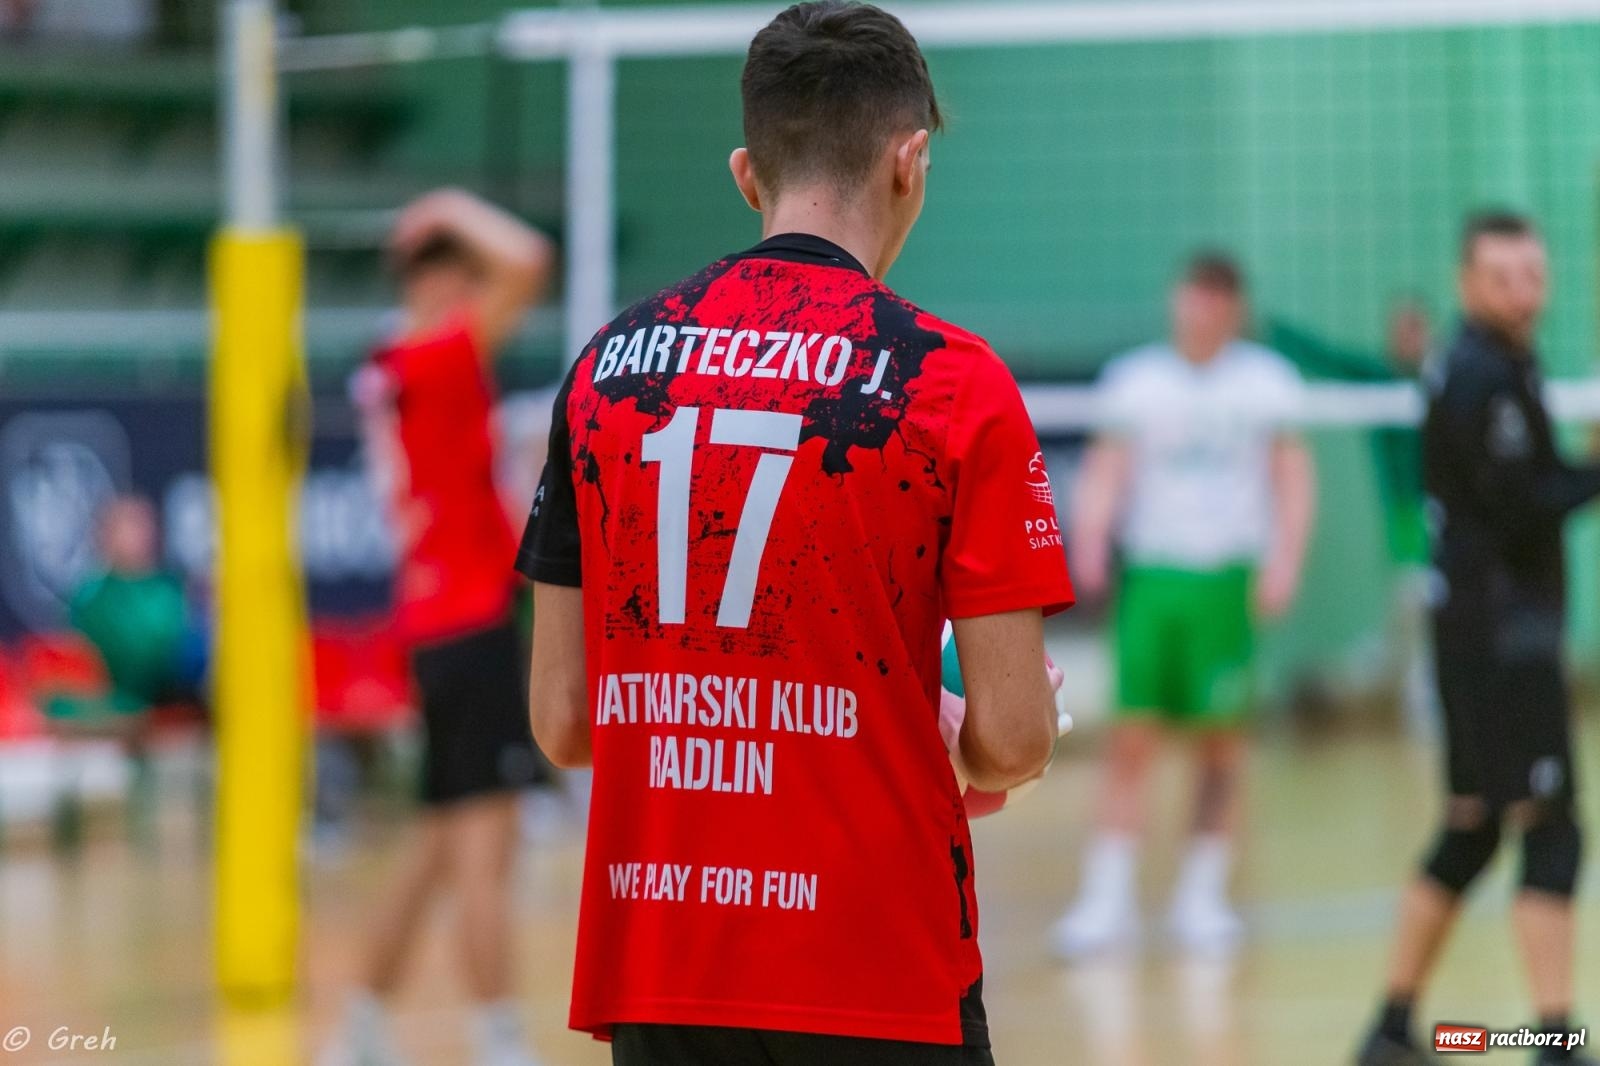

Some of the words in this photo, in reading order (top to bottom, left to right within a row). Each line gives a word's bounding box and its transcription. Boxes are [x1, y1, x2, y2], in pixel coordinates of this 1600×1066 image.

[593, 325, 853, 387] BARTECZKO
[860, 349, 893, 400] J.
[641, 406, 804, 629] 17
[770, 680, 858, 738] KLUB
[649, 735, 774, 795] RADLIN
[608, 862, 642, 899] WE
[643, 863, 692, 902] PLAY
[700, 866, 753, 906] FOR
[762, 870, 818, 911] FUN
